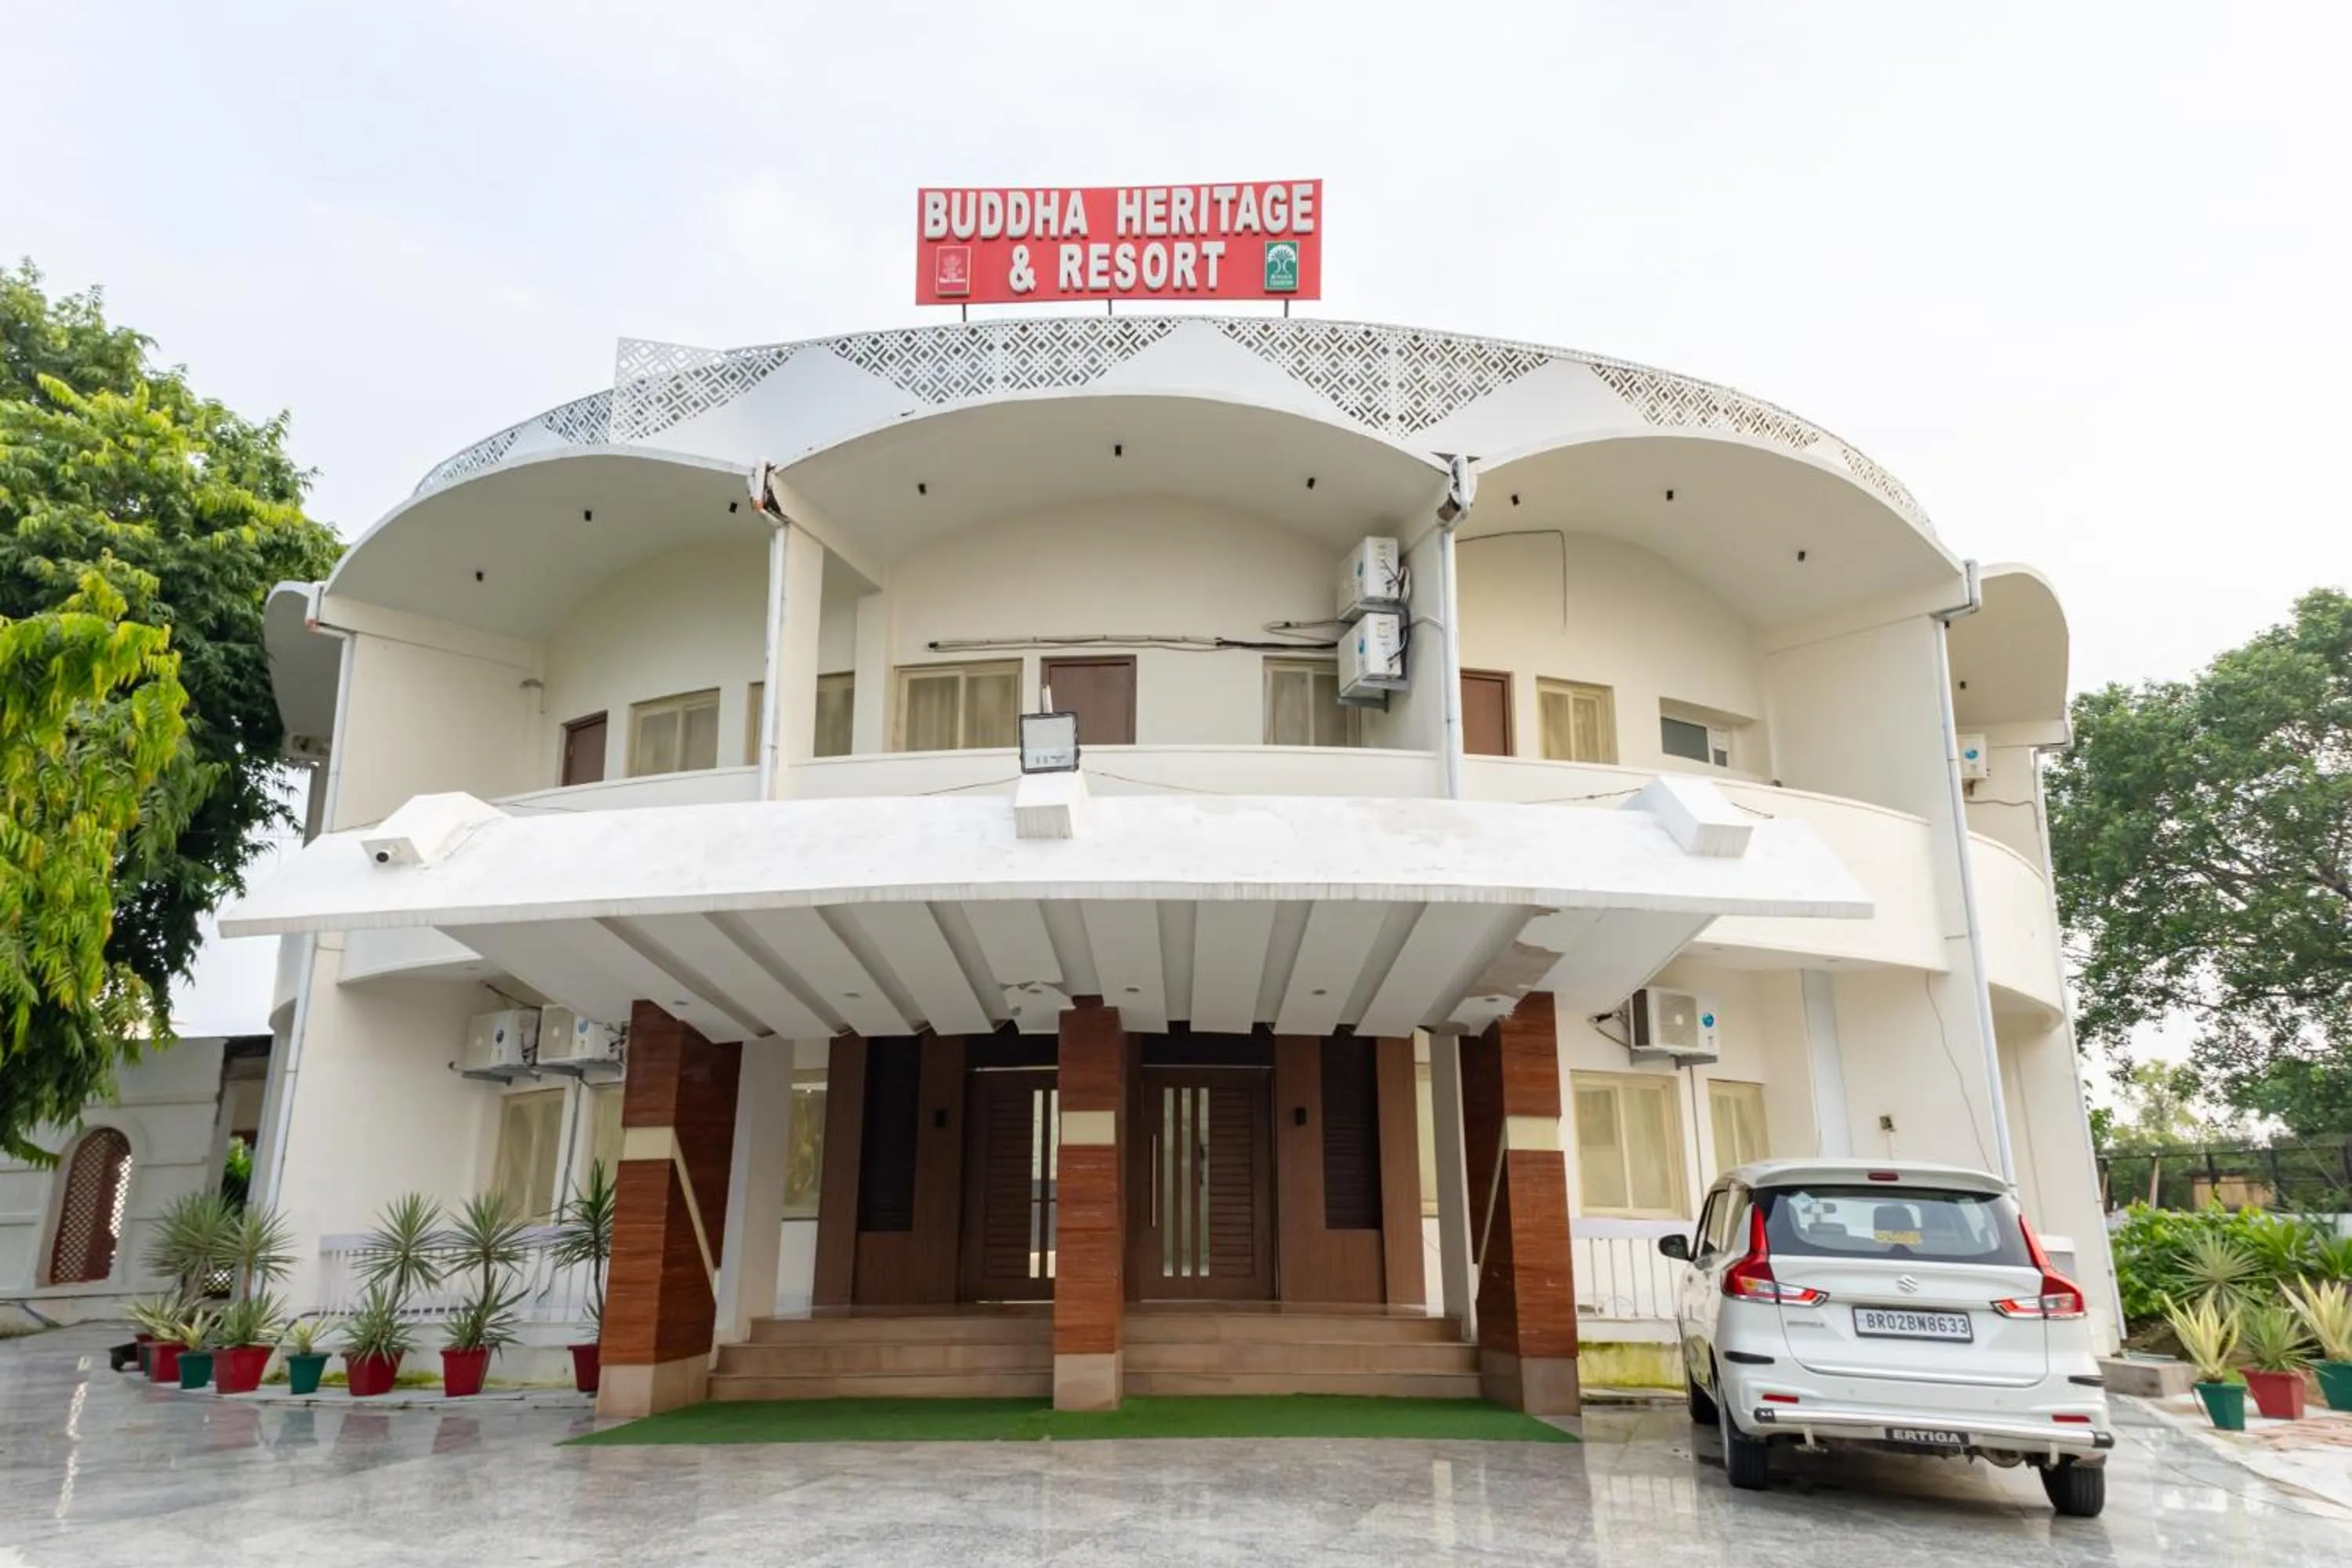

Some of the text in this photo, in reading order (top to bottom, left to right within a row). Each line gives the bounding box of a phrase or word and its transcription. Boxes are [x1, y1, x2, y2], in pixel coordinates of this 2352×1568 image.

[924, 184, 1314, 239] BUDDHA HERITAGE
[1010, 241, 1225, 292] & RESORT
[1866, 1313, 1969, 1334] BR02BN8633
[1893, 1429, 1961, 1443] ERTIGA
